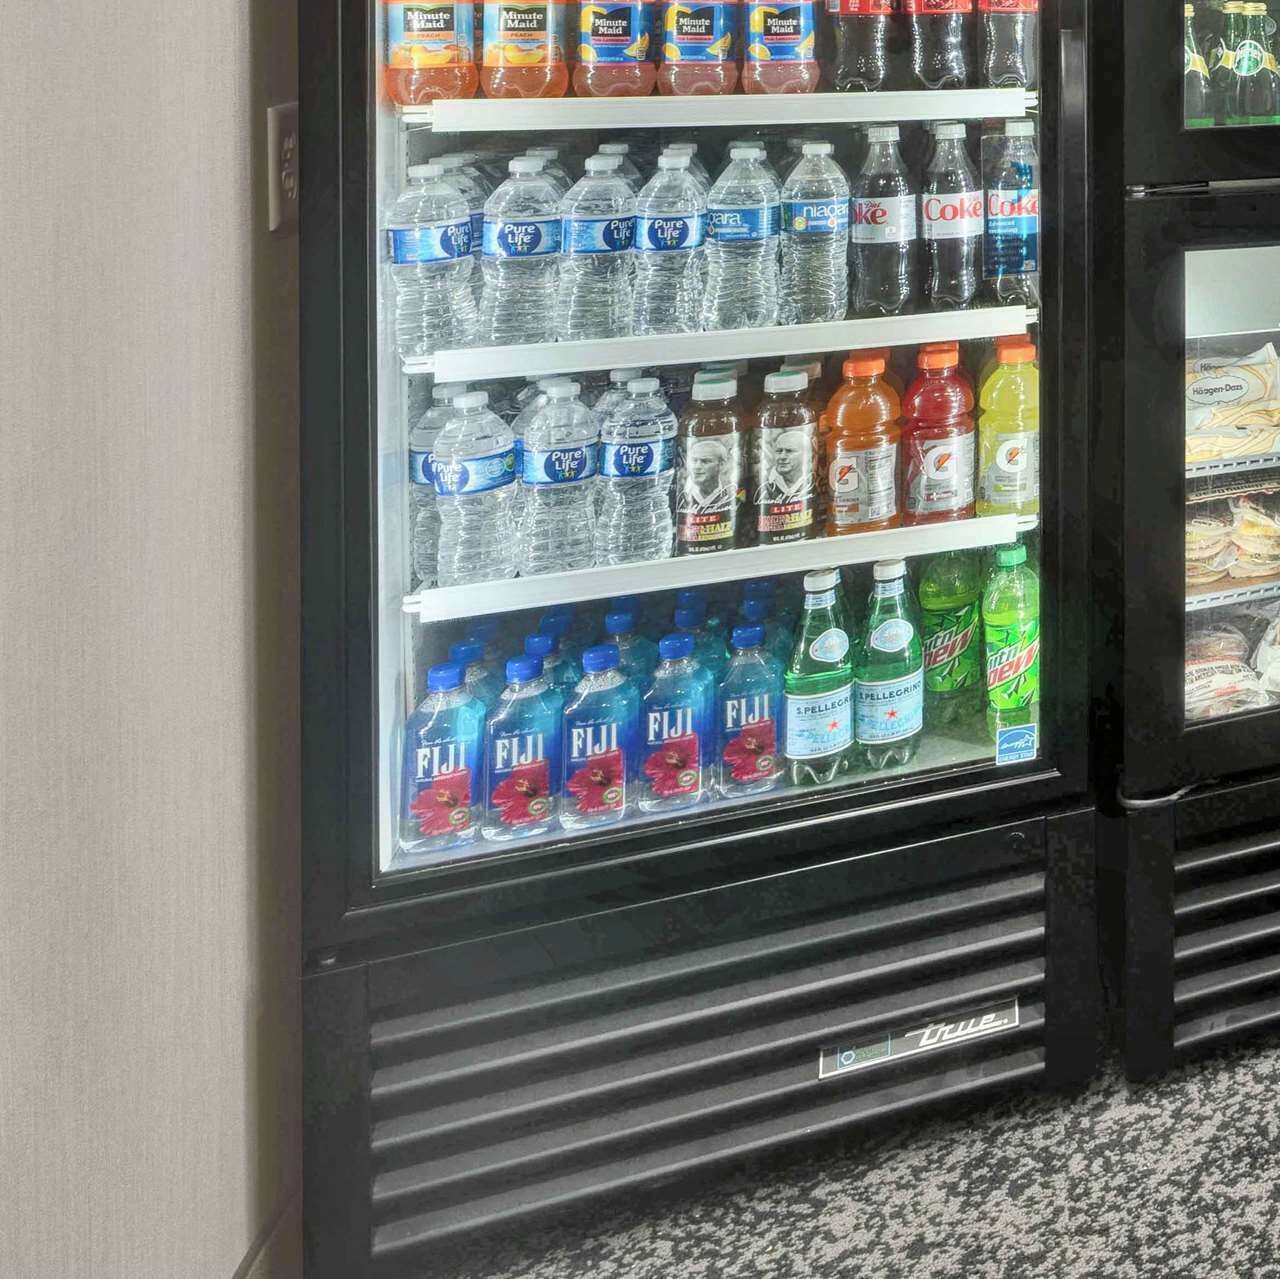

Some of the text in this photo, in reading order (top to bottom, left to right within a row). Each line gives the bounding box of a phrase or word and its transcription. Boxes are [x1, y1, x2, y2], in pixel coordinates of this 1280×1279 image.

[406, 10, 450, 20] Minute
[414, 19, 445, 29] Maid
[594, 18, 628, 27] Minute
[598, 26, 623, 35] Maid
[924, 199, 982, 221] Coke
[988, 194, 1039, 216] Coke
[1193, 384, 1243, 395] Häagen-Dazs
[620, 444, 648, 456] Pure
[552, 451, 582, 462] Pure
[622, 454, 644, 465] Life
[555, 460, 578, 470] Life
[830, 456, 859, 491] G
[725, 694, 769, 729] FIJI
[648, 708, 694, 741] FIJI
[496, 733, 544, 768] FIJI
